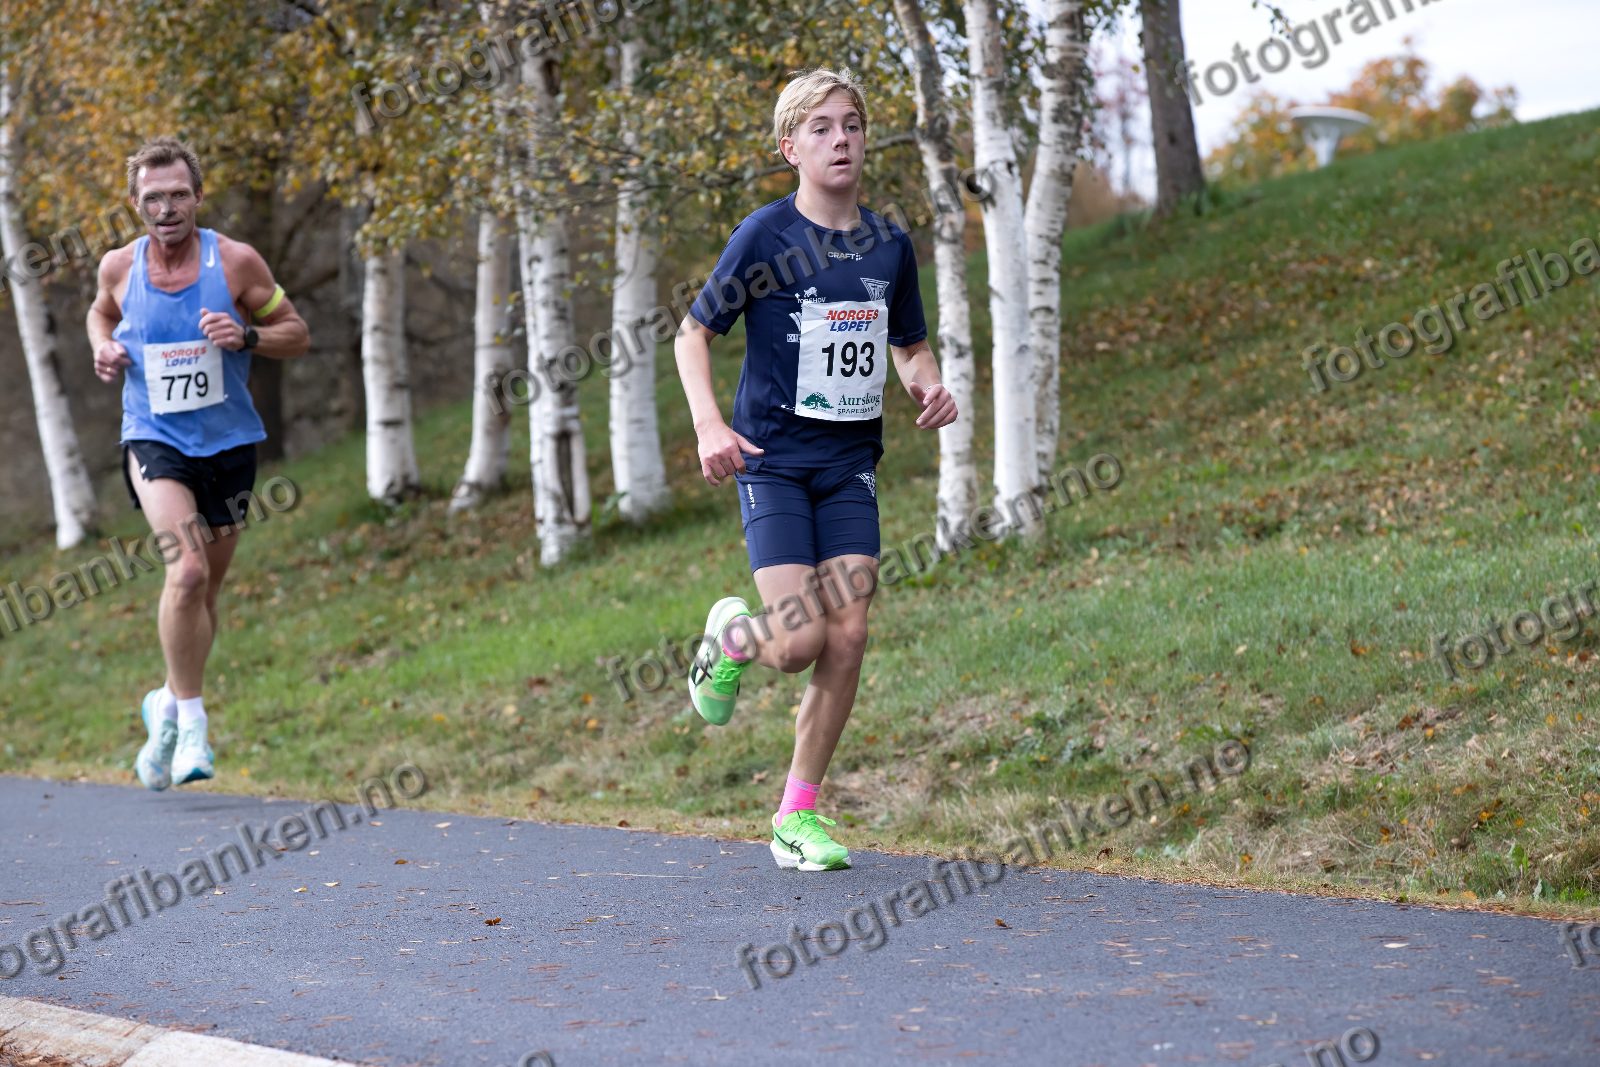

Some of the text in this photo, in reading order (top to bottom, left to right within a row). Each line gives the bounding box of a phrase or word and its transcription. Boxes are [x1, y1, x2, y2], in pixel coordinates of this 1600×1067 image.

[828, 251, 855, 260] CRAFT
[825, 309, 879, 320] NORGES
[830, 320, 872, 332] LØPET
[161, 345, 207, 358] NORGES
[821, 341, 875, 377] 193
[161, 371, 209, 401] 779
[838, 393, 881, 407] Aurskog
